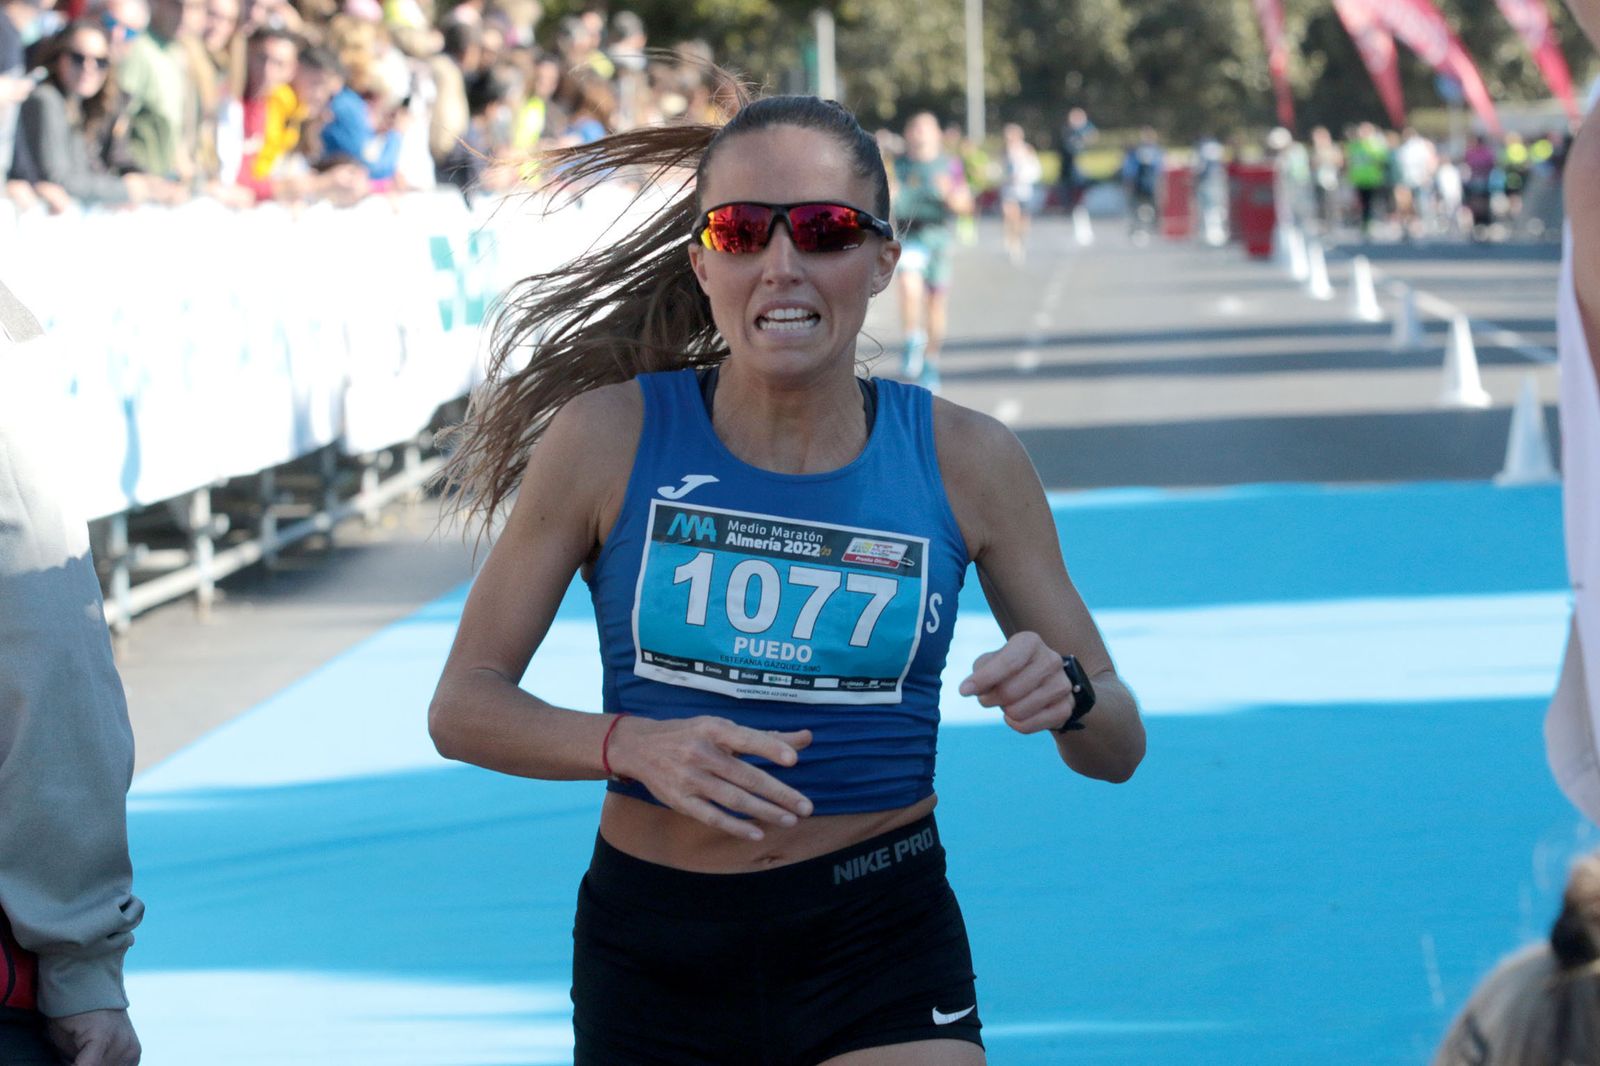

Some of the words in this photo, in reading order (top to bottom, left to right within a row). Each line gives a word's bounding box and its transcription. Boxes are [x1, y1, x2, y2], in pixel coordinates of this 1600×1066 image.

[725, 532, 782, 552] Almería
[727, 520, 767, 536] Medio
[771, 526, 824, 543] Maratón
[673, 550, 899, 648] 1077
[733, 636, 812, 663] PUEDO
[833, 846, 892, 885] NIKE
[894, 827, 934, 863] PRO
